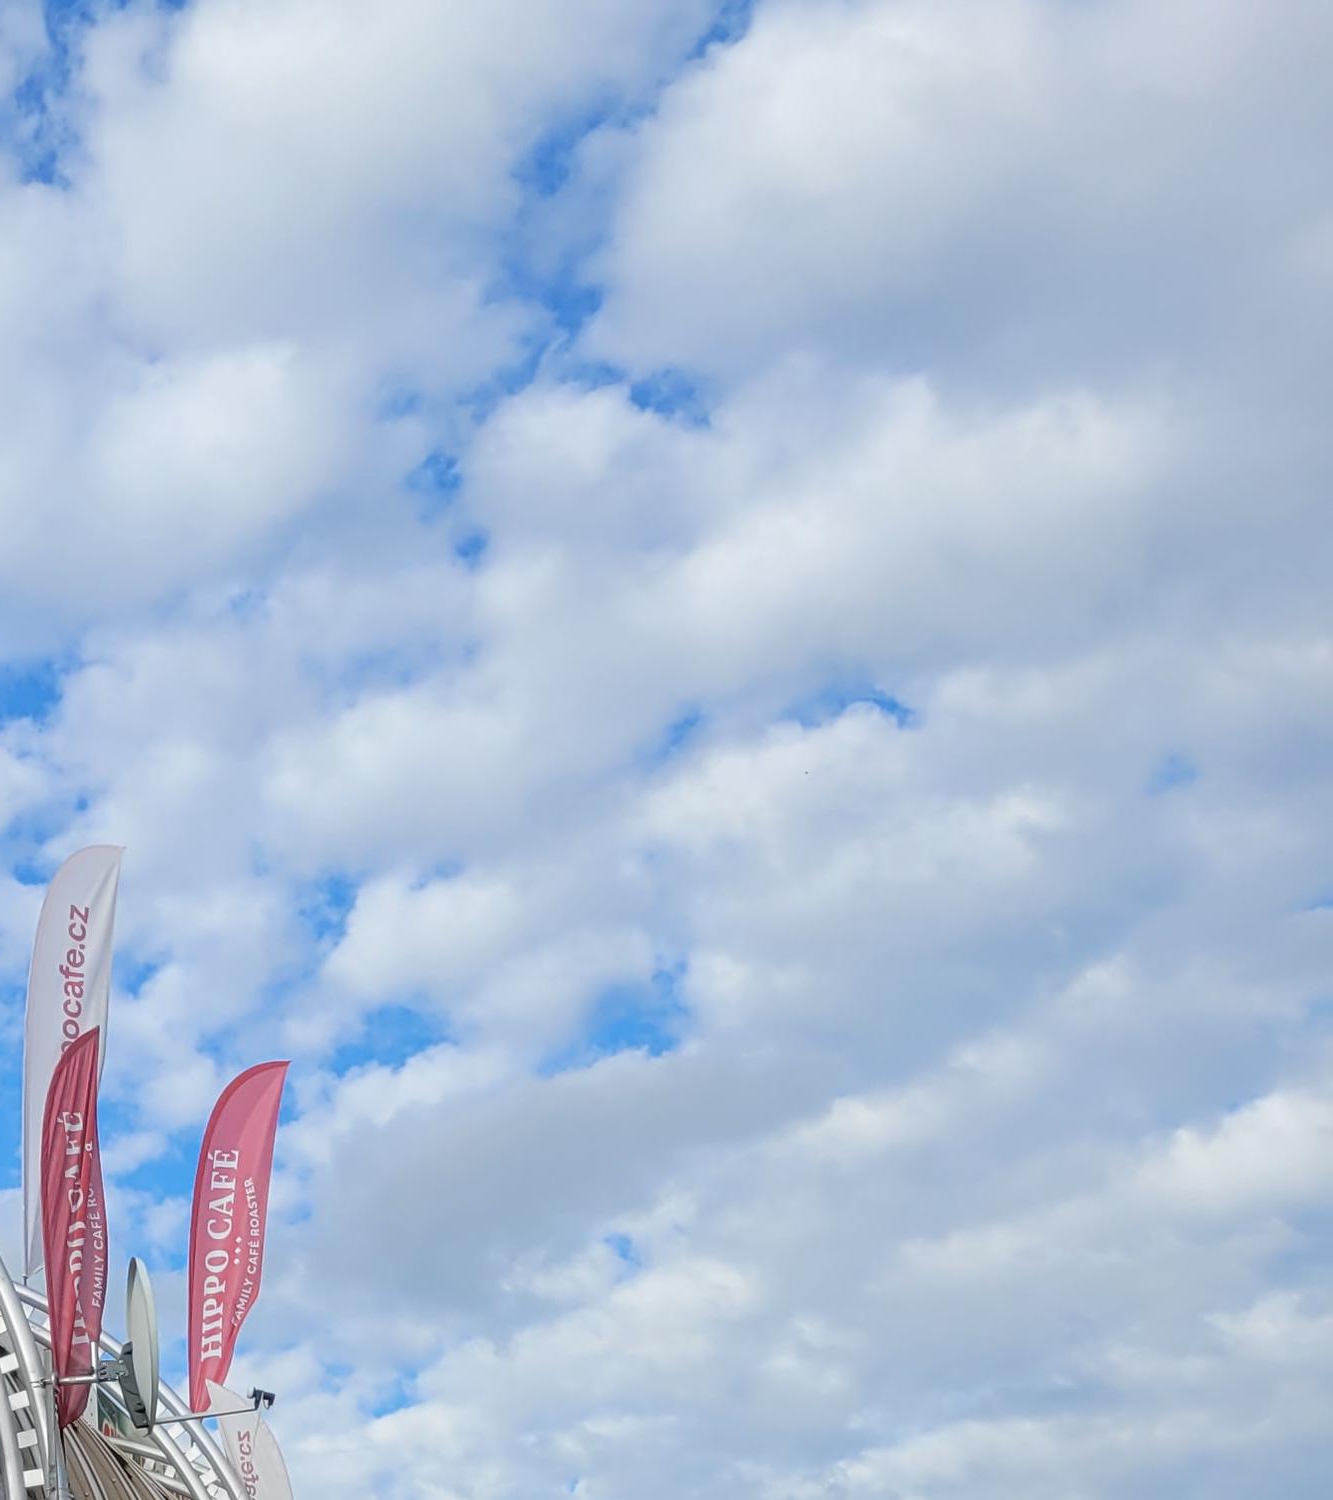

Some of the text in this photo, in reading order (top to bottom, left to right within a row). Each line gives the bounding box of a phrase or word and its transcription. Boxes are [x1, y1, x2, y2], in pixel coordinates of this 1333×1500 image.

[244, 1177, 259, 1237] ROASTER
[92, 1256, 105, 1308] FAMILY
[200, 1149, 239, 1363] HIPPO CAFÉ
[247, 1240, 259, 1275] CAFÉ
